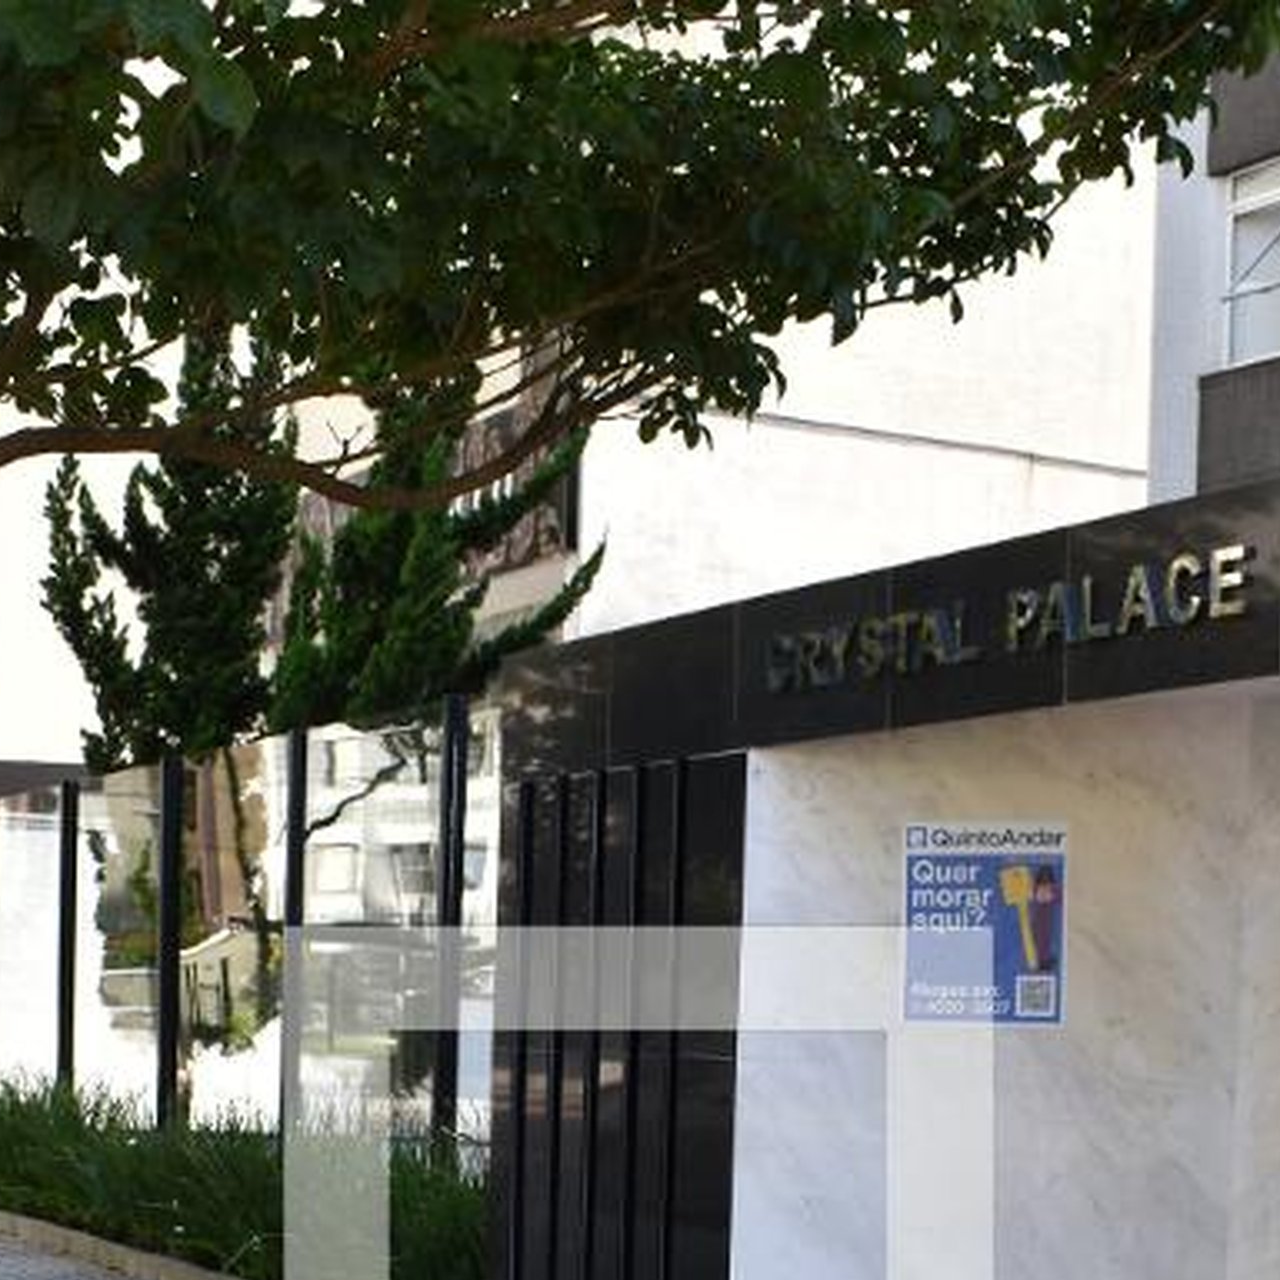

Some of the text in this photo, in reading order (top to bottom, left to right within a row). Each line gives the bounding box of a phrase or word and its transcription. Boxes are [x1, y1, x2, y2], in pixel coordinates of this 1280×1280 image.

[766, 543, 1257, 693] CRYSTAL PALACE
[930, 828, 1067, 848] QuintoAndar
[911, 858, 981, 885] Quer
[911, 887, 993, 909] morar
